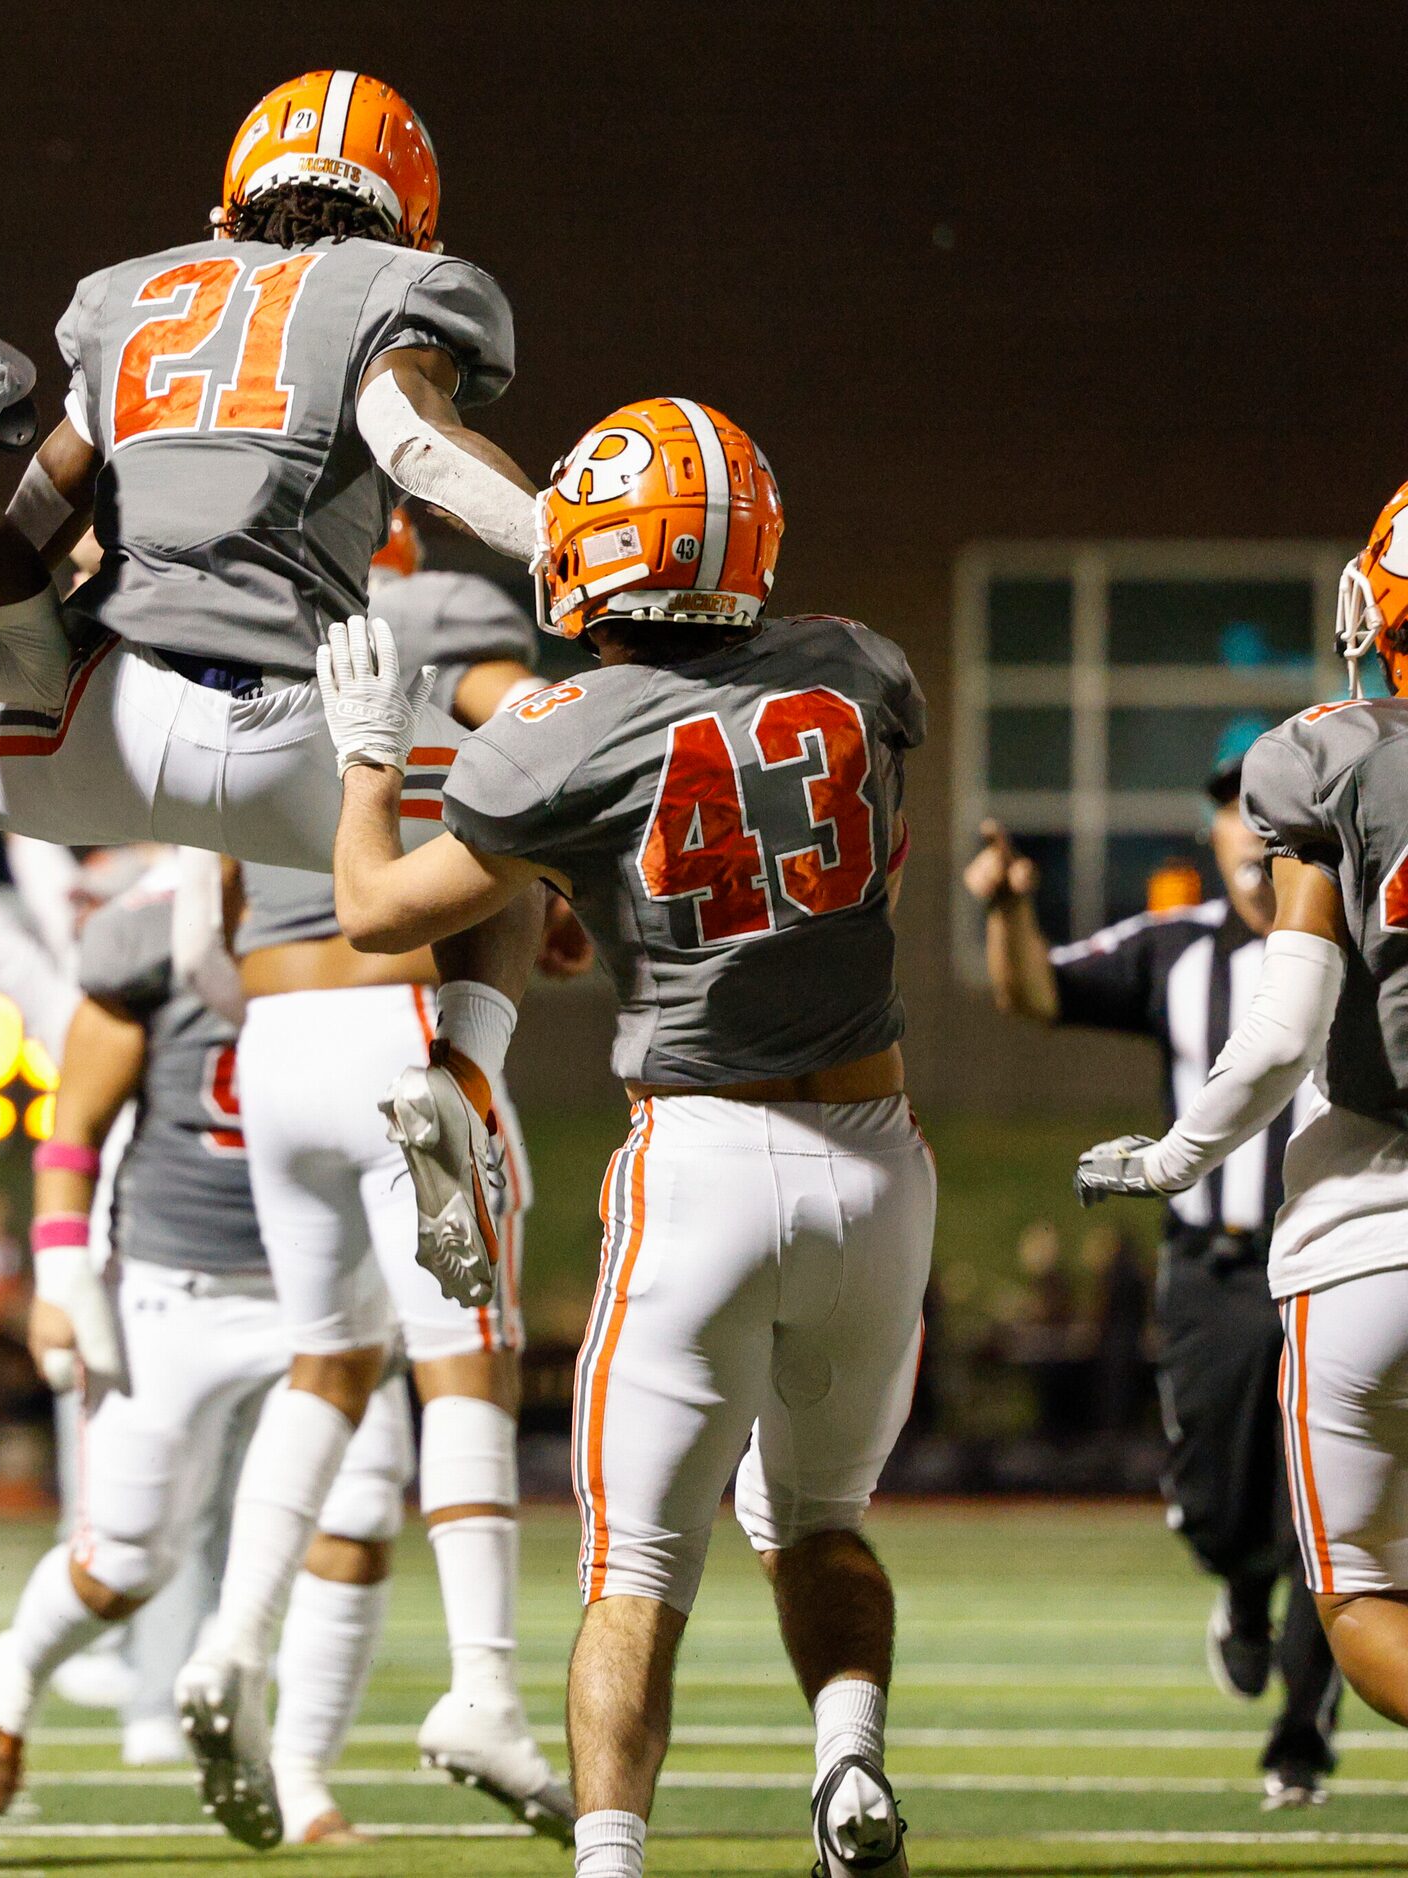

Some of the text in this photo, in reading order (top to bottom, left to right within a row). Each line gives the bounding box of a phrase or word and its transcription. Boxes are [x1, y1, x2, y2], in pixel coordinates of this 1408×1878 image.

[296, 112, 312, 129] 21
[111, 252, 328, 453] 21
[676, 538, 695, 560] 43
[668, 592, 738, 614] JACKETS
[635, 684, 877, 947] 43
